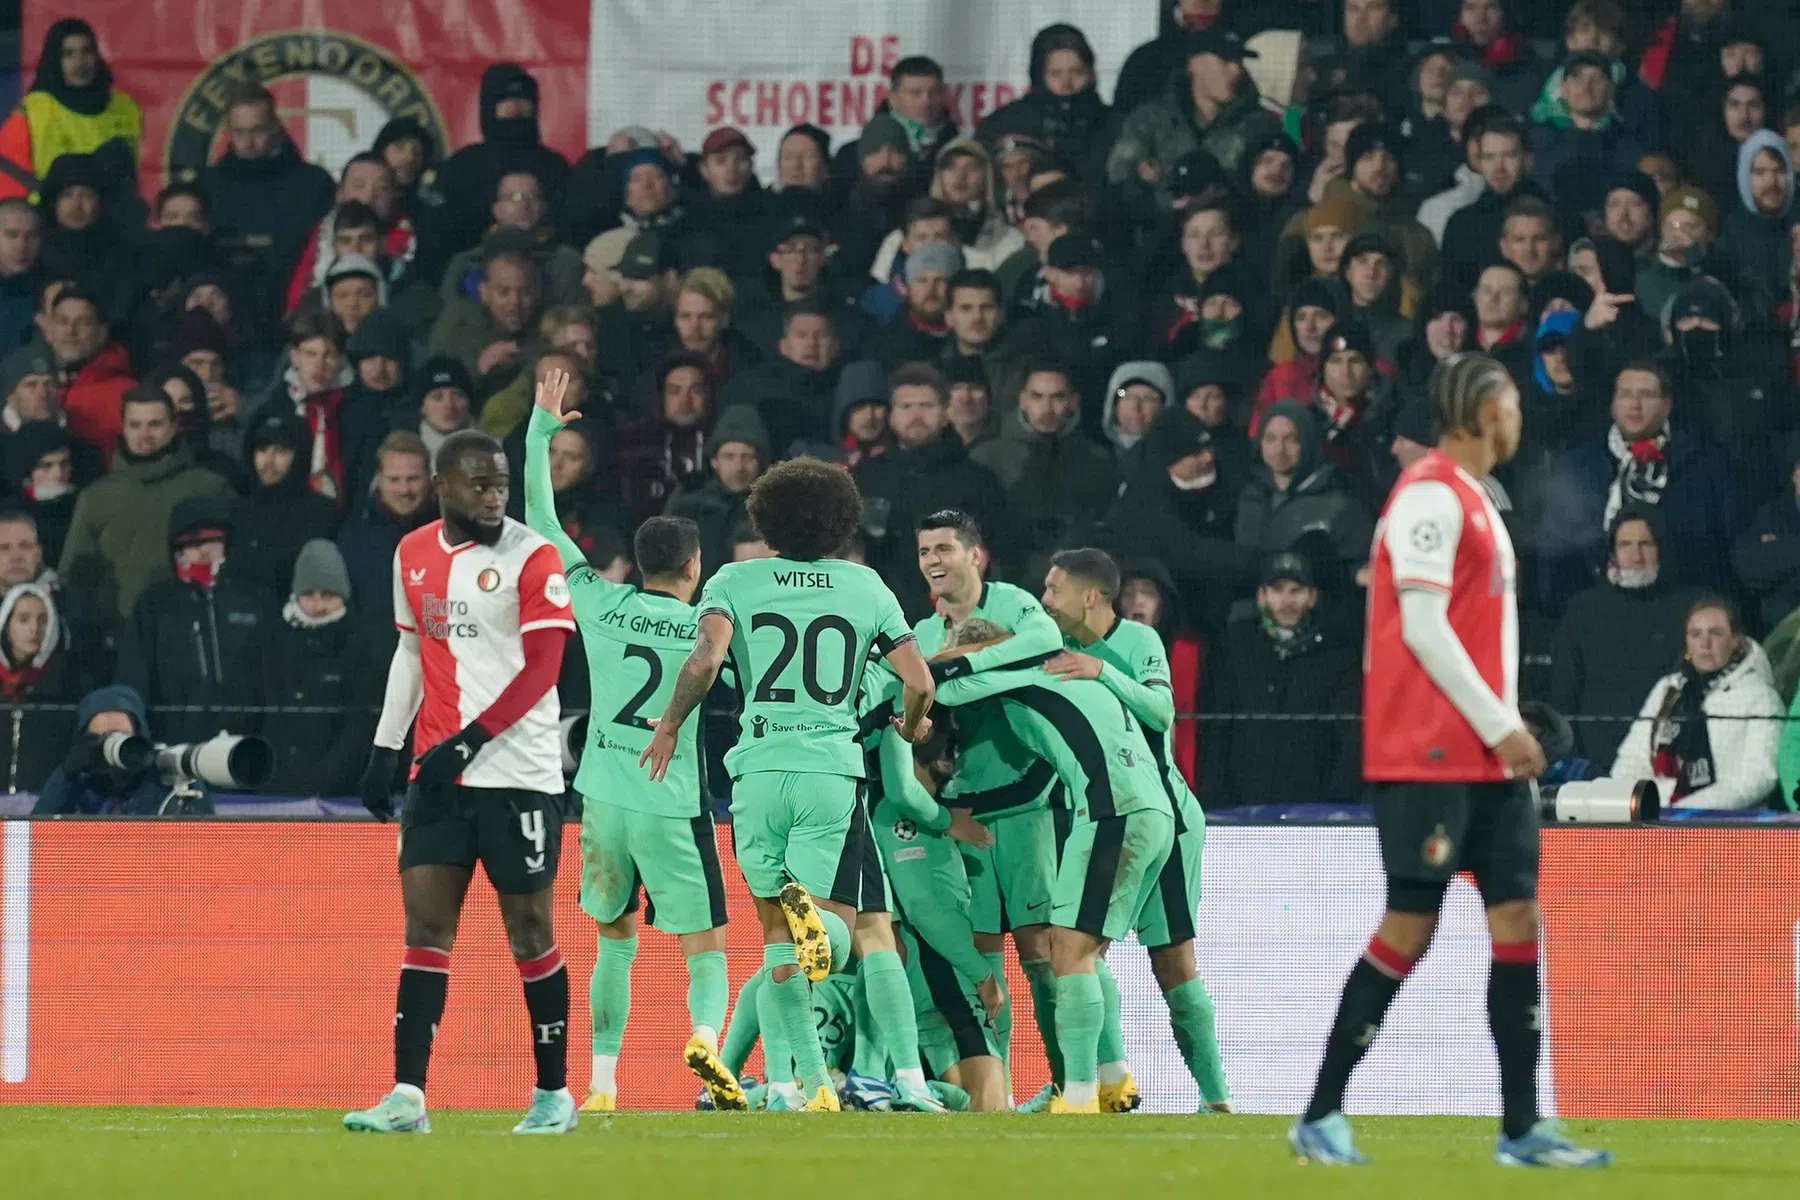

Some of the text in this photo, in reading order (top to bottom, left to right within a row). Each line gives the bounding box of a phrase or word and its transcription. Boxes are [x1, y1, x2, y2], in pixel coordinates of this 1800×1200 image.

[850, 35, 900, 77] DE
[773, 571, 834, 589] WITSEL
[423, 594, 469, 616] Euro
[424, 618, 479, 638] Parcs
[751, 611, 858, 707] 20
[611, 643, 664, 732] 2
[771, 722, 795, 732] Save
[796, 723, 813, 732] the
[607, 739, 642, 757] Save the
[520, 809, 547, 852] 4
[536, 1020, 565, 1044] F
